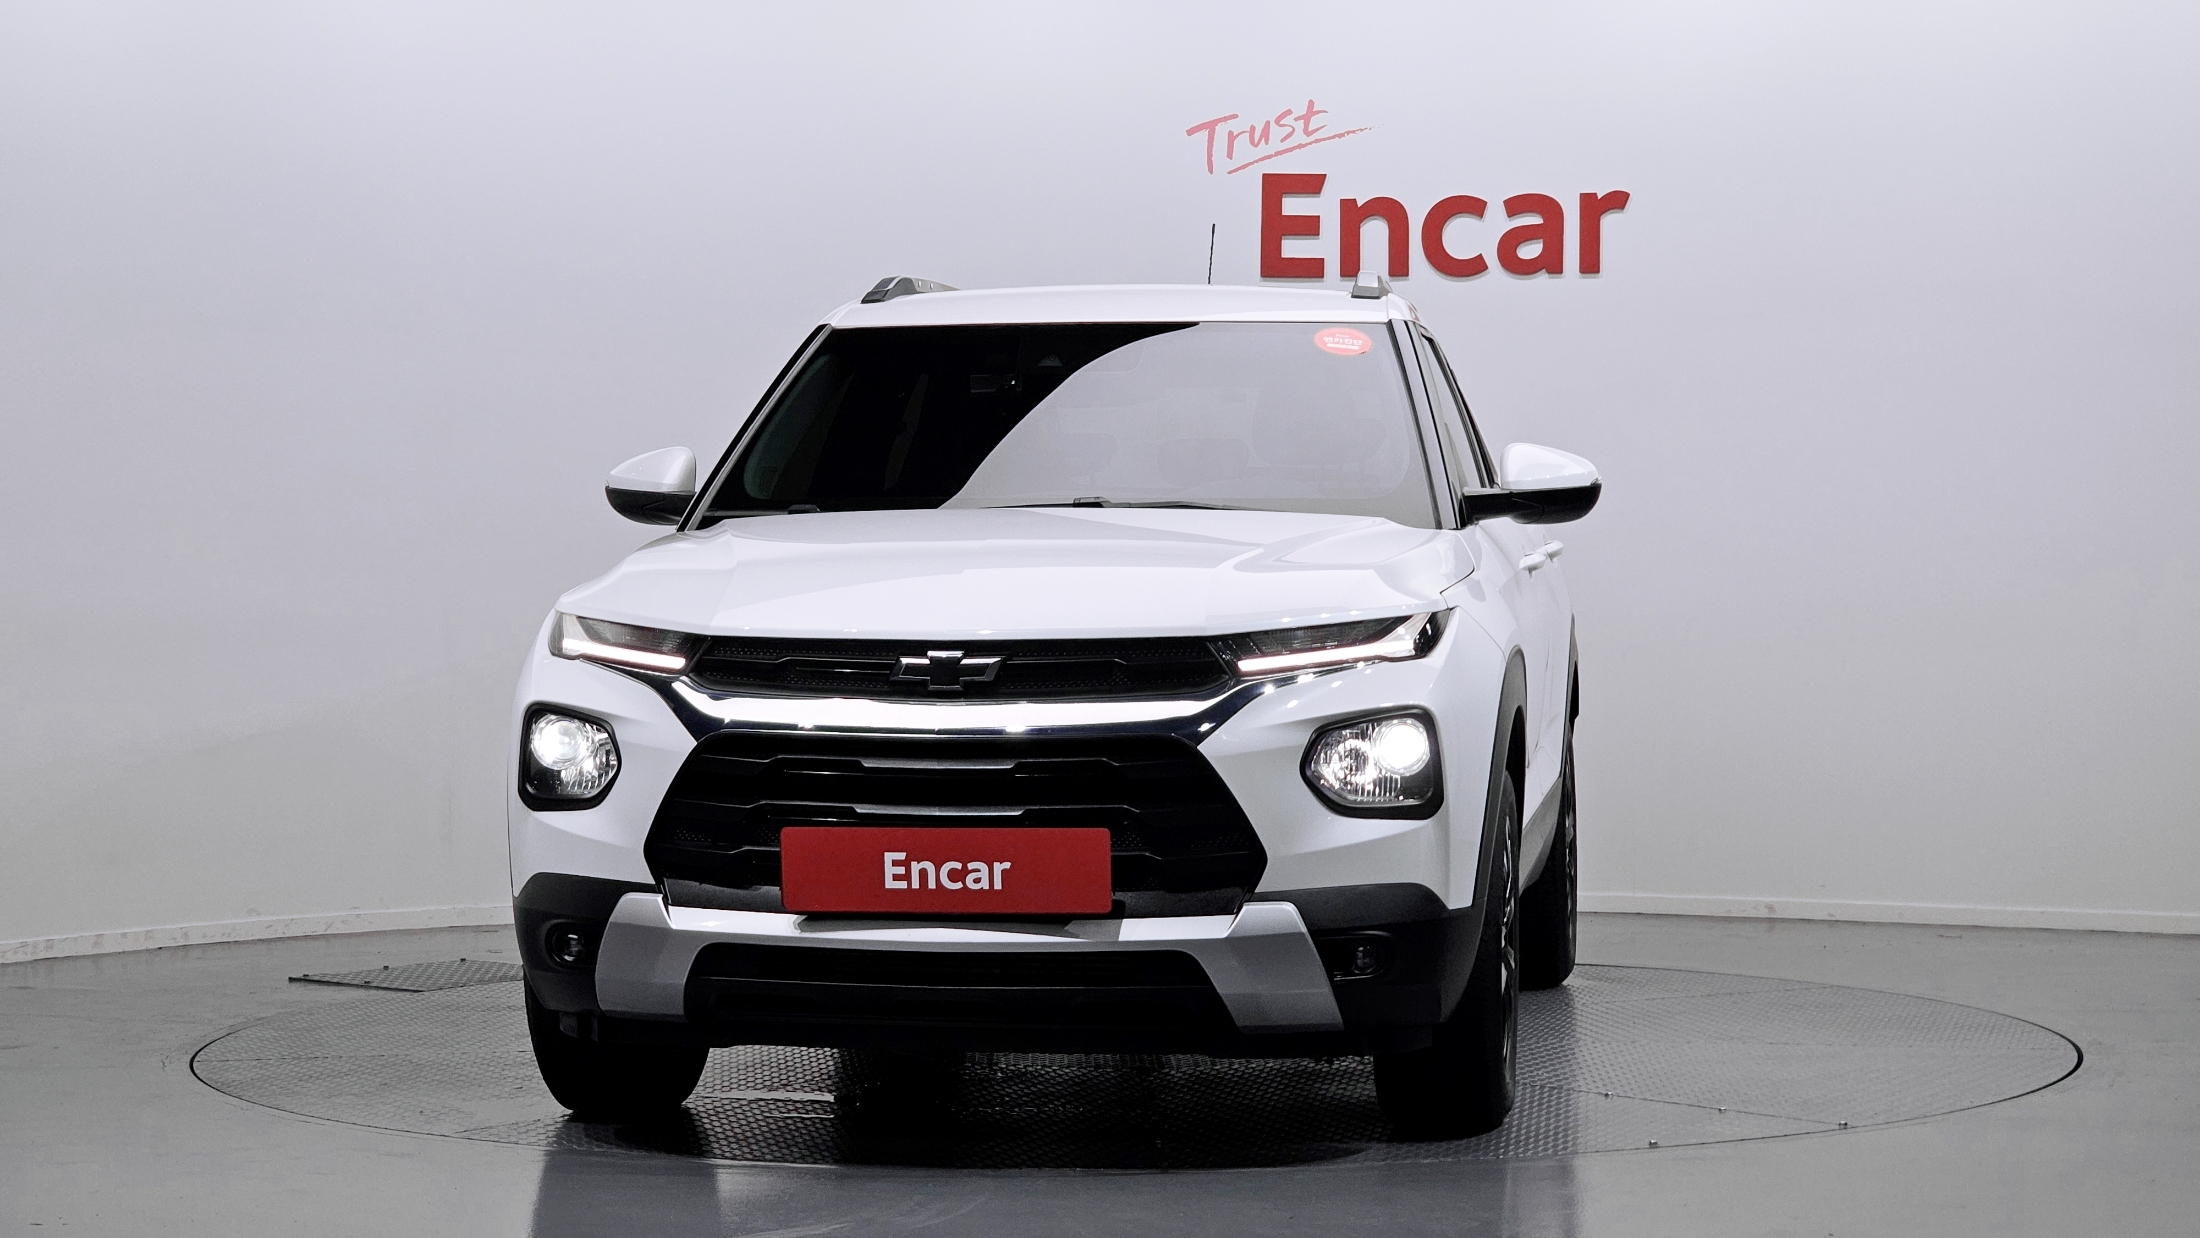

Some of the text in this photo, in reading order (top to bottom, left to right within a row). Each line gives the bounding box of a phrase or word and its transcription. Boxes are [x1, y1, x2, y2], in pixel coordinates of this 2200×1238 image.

[1185, 99, 1330, 175] Trust
[1259, 171, 1631, 279] Encar
[883, 851, 1012, 890] Encar
